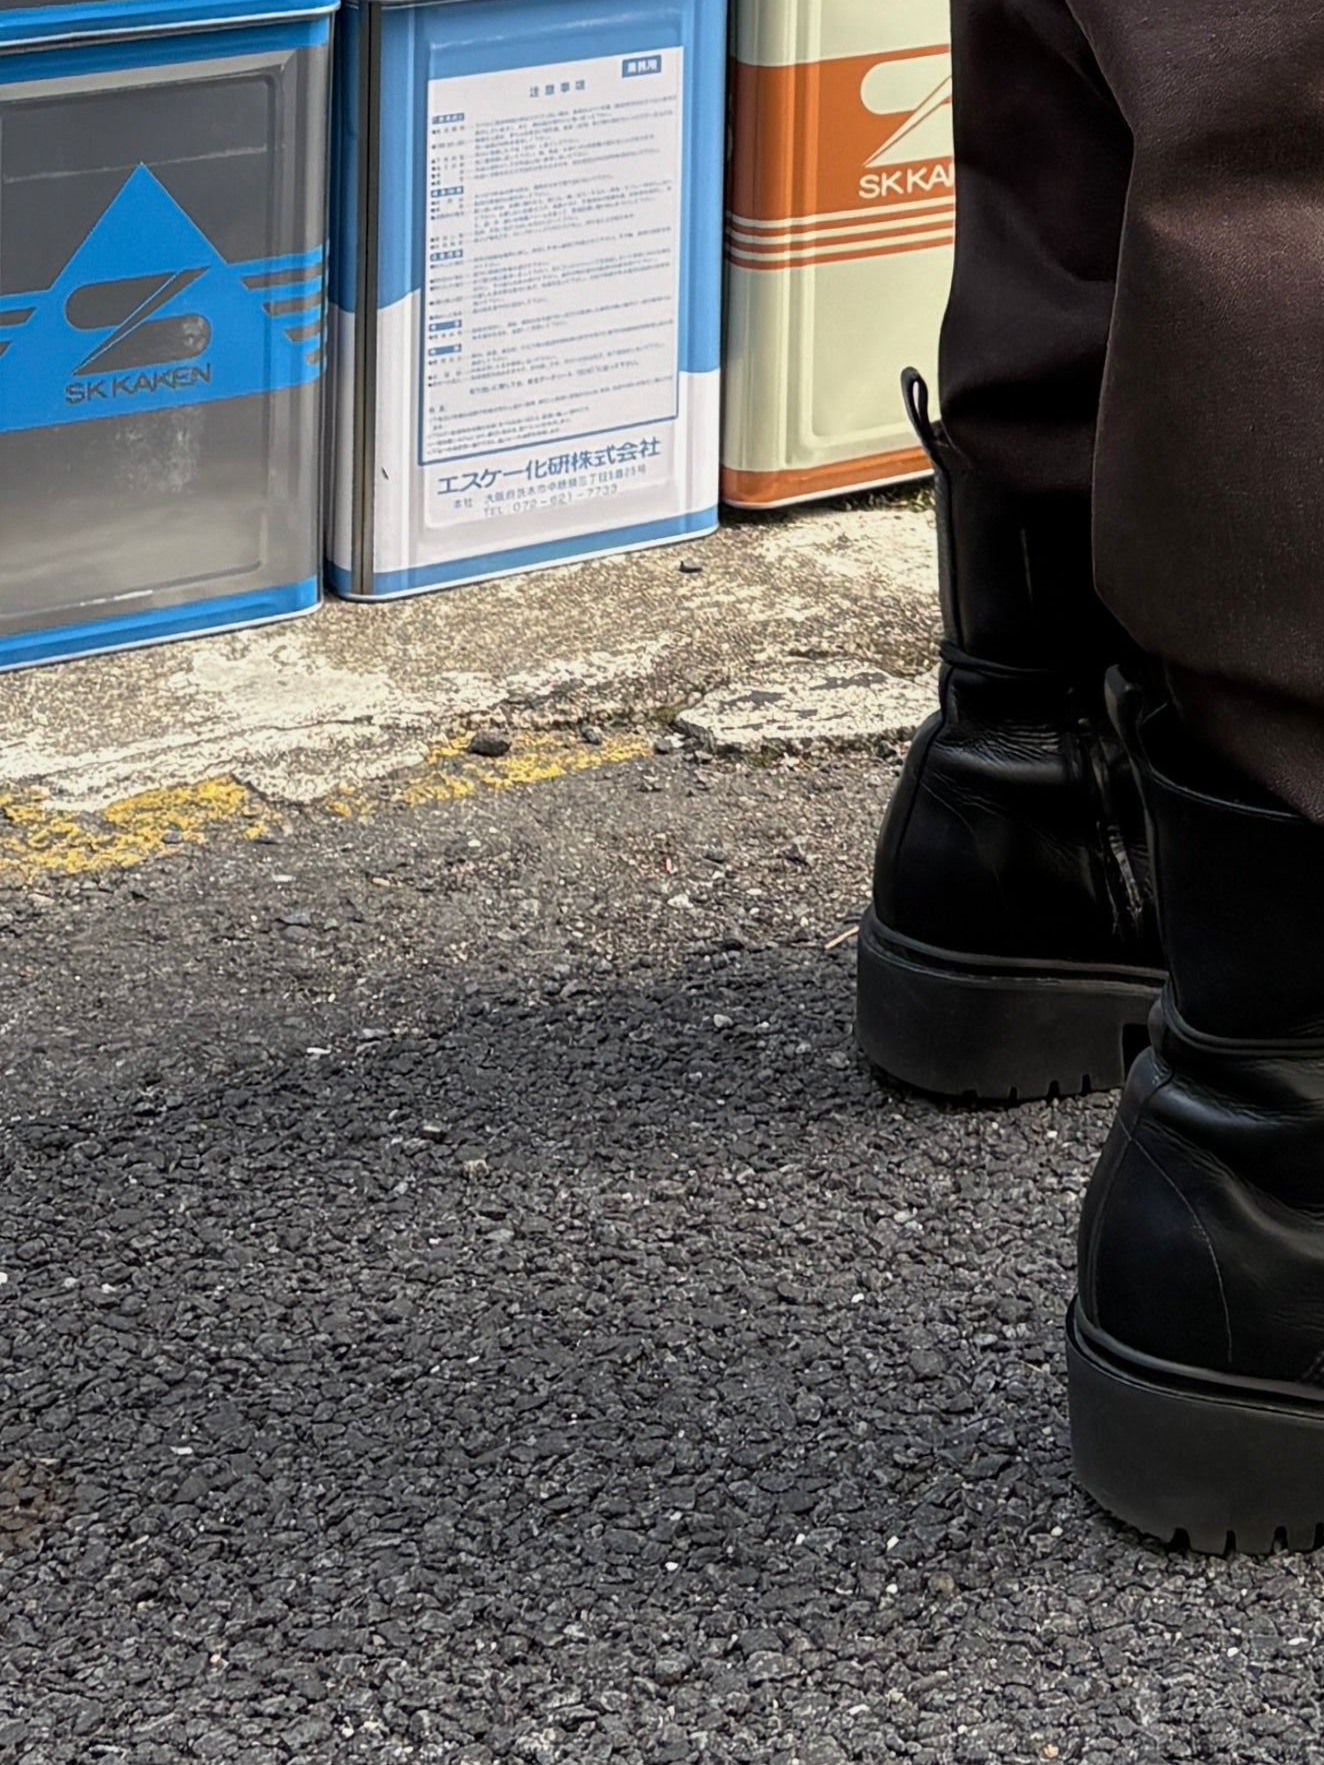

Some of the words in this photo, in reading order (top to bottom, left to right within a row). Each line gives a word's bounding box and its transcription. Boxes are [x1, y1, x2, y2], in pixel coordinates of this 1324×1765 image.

[858, 170, 904, 199] SK
[65, 380, 108, 405] SK
[112, 362, 211, 399] KAKEN
[437, 436, 661, 495] エスケー化研株式会社
